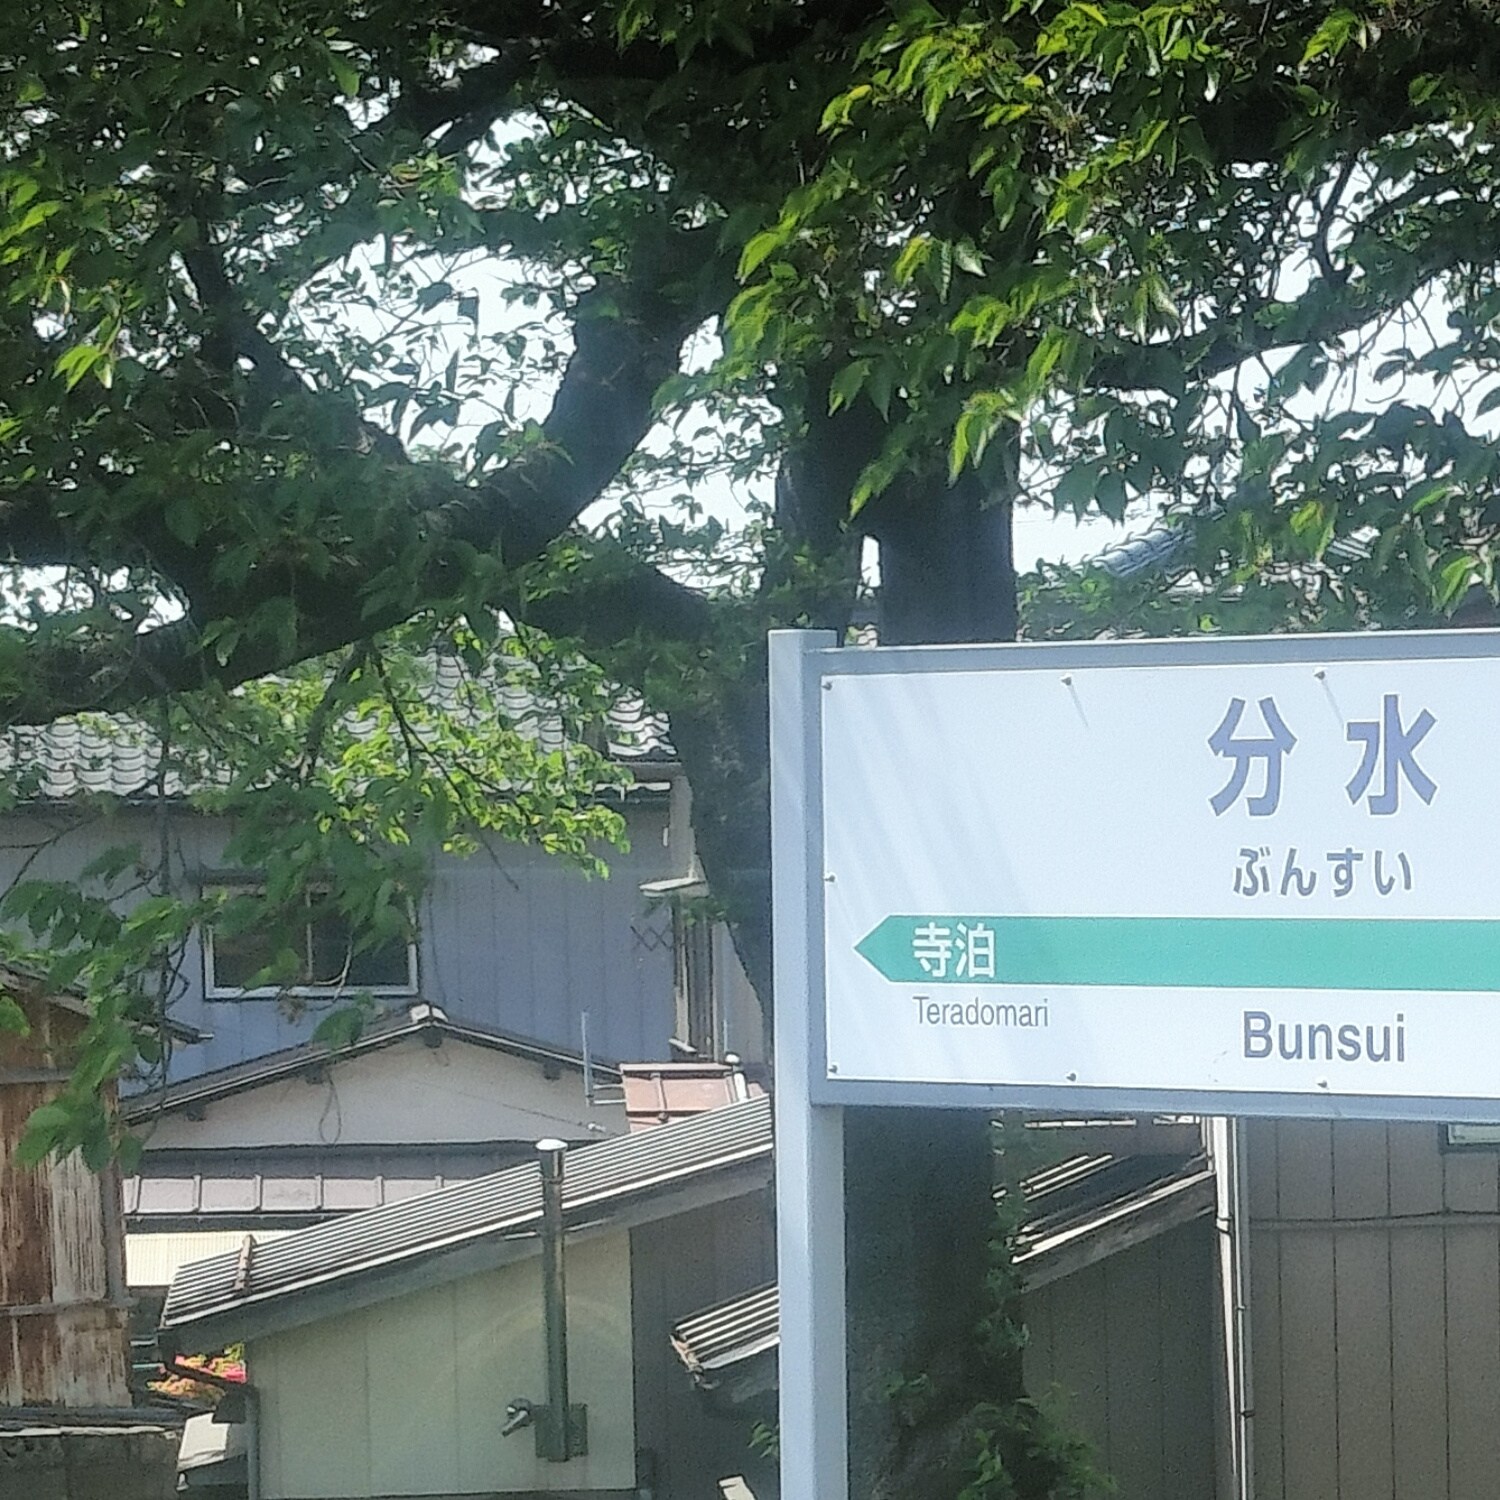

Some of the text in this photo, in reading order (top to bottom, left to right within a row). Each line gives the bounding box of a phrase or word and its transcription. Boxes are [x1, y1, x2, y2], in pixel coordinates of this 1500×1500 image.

[1207, 693, 1438, 817] 分水
[1233, 846, 1412, 898] ぶんすい
[911, 921, 996, 978] 寺泊
[912, 996, 1049, 1027] Teradomari
[1243, 1010, 1405, 1063] Bunsui
